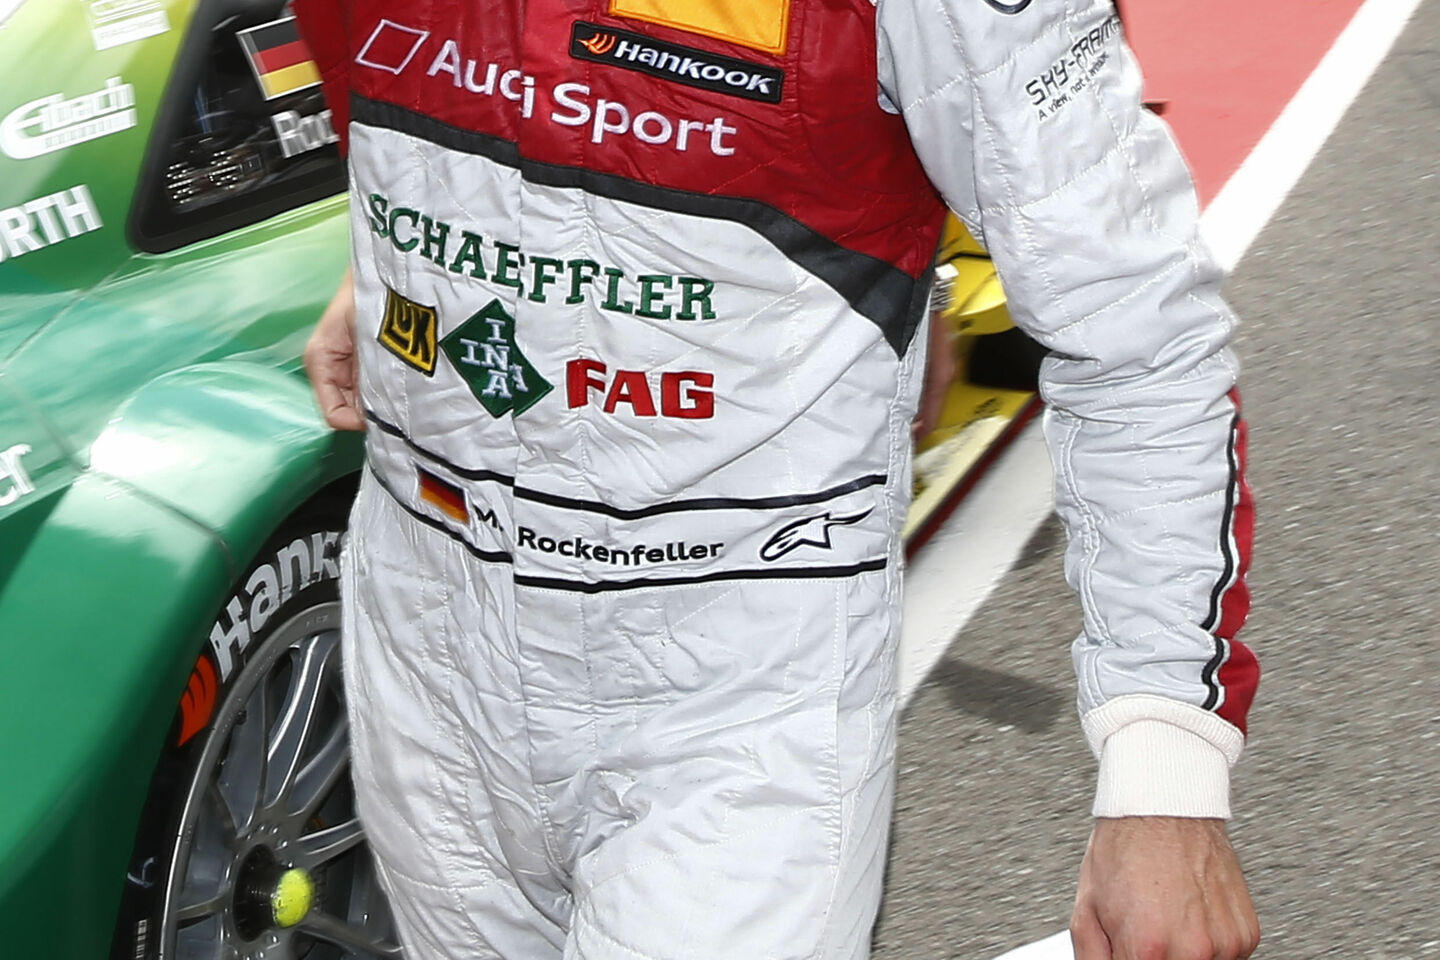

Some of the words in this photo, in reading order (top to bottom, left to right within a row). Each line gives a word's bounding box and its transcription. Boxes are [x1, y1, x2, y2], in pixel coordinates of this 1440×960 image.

[550, 81, 738, 157] Sport
[367, 194, 717, 321] SCHAEFFLER
[566, 360, 715, 420] FAG
[472, 503, 505, 531] M.
[517, 526, 724, 566] Rockenfeller
